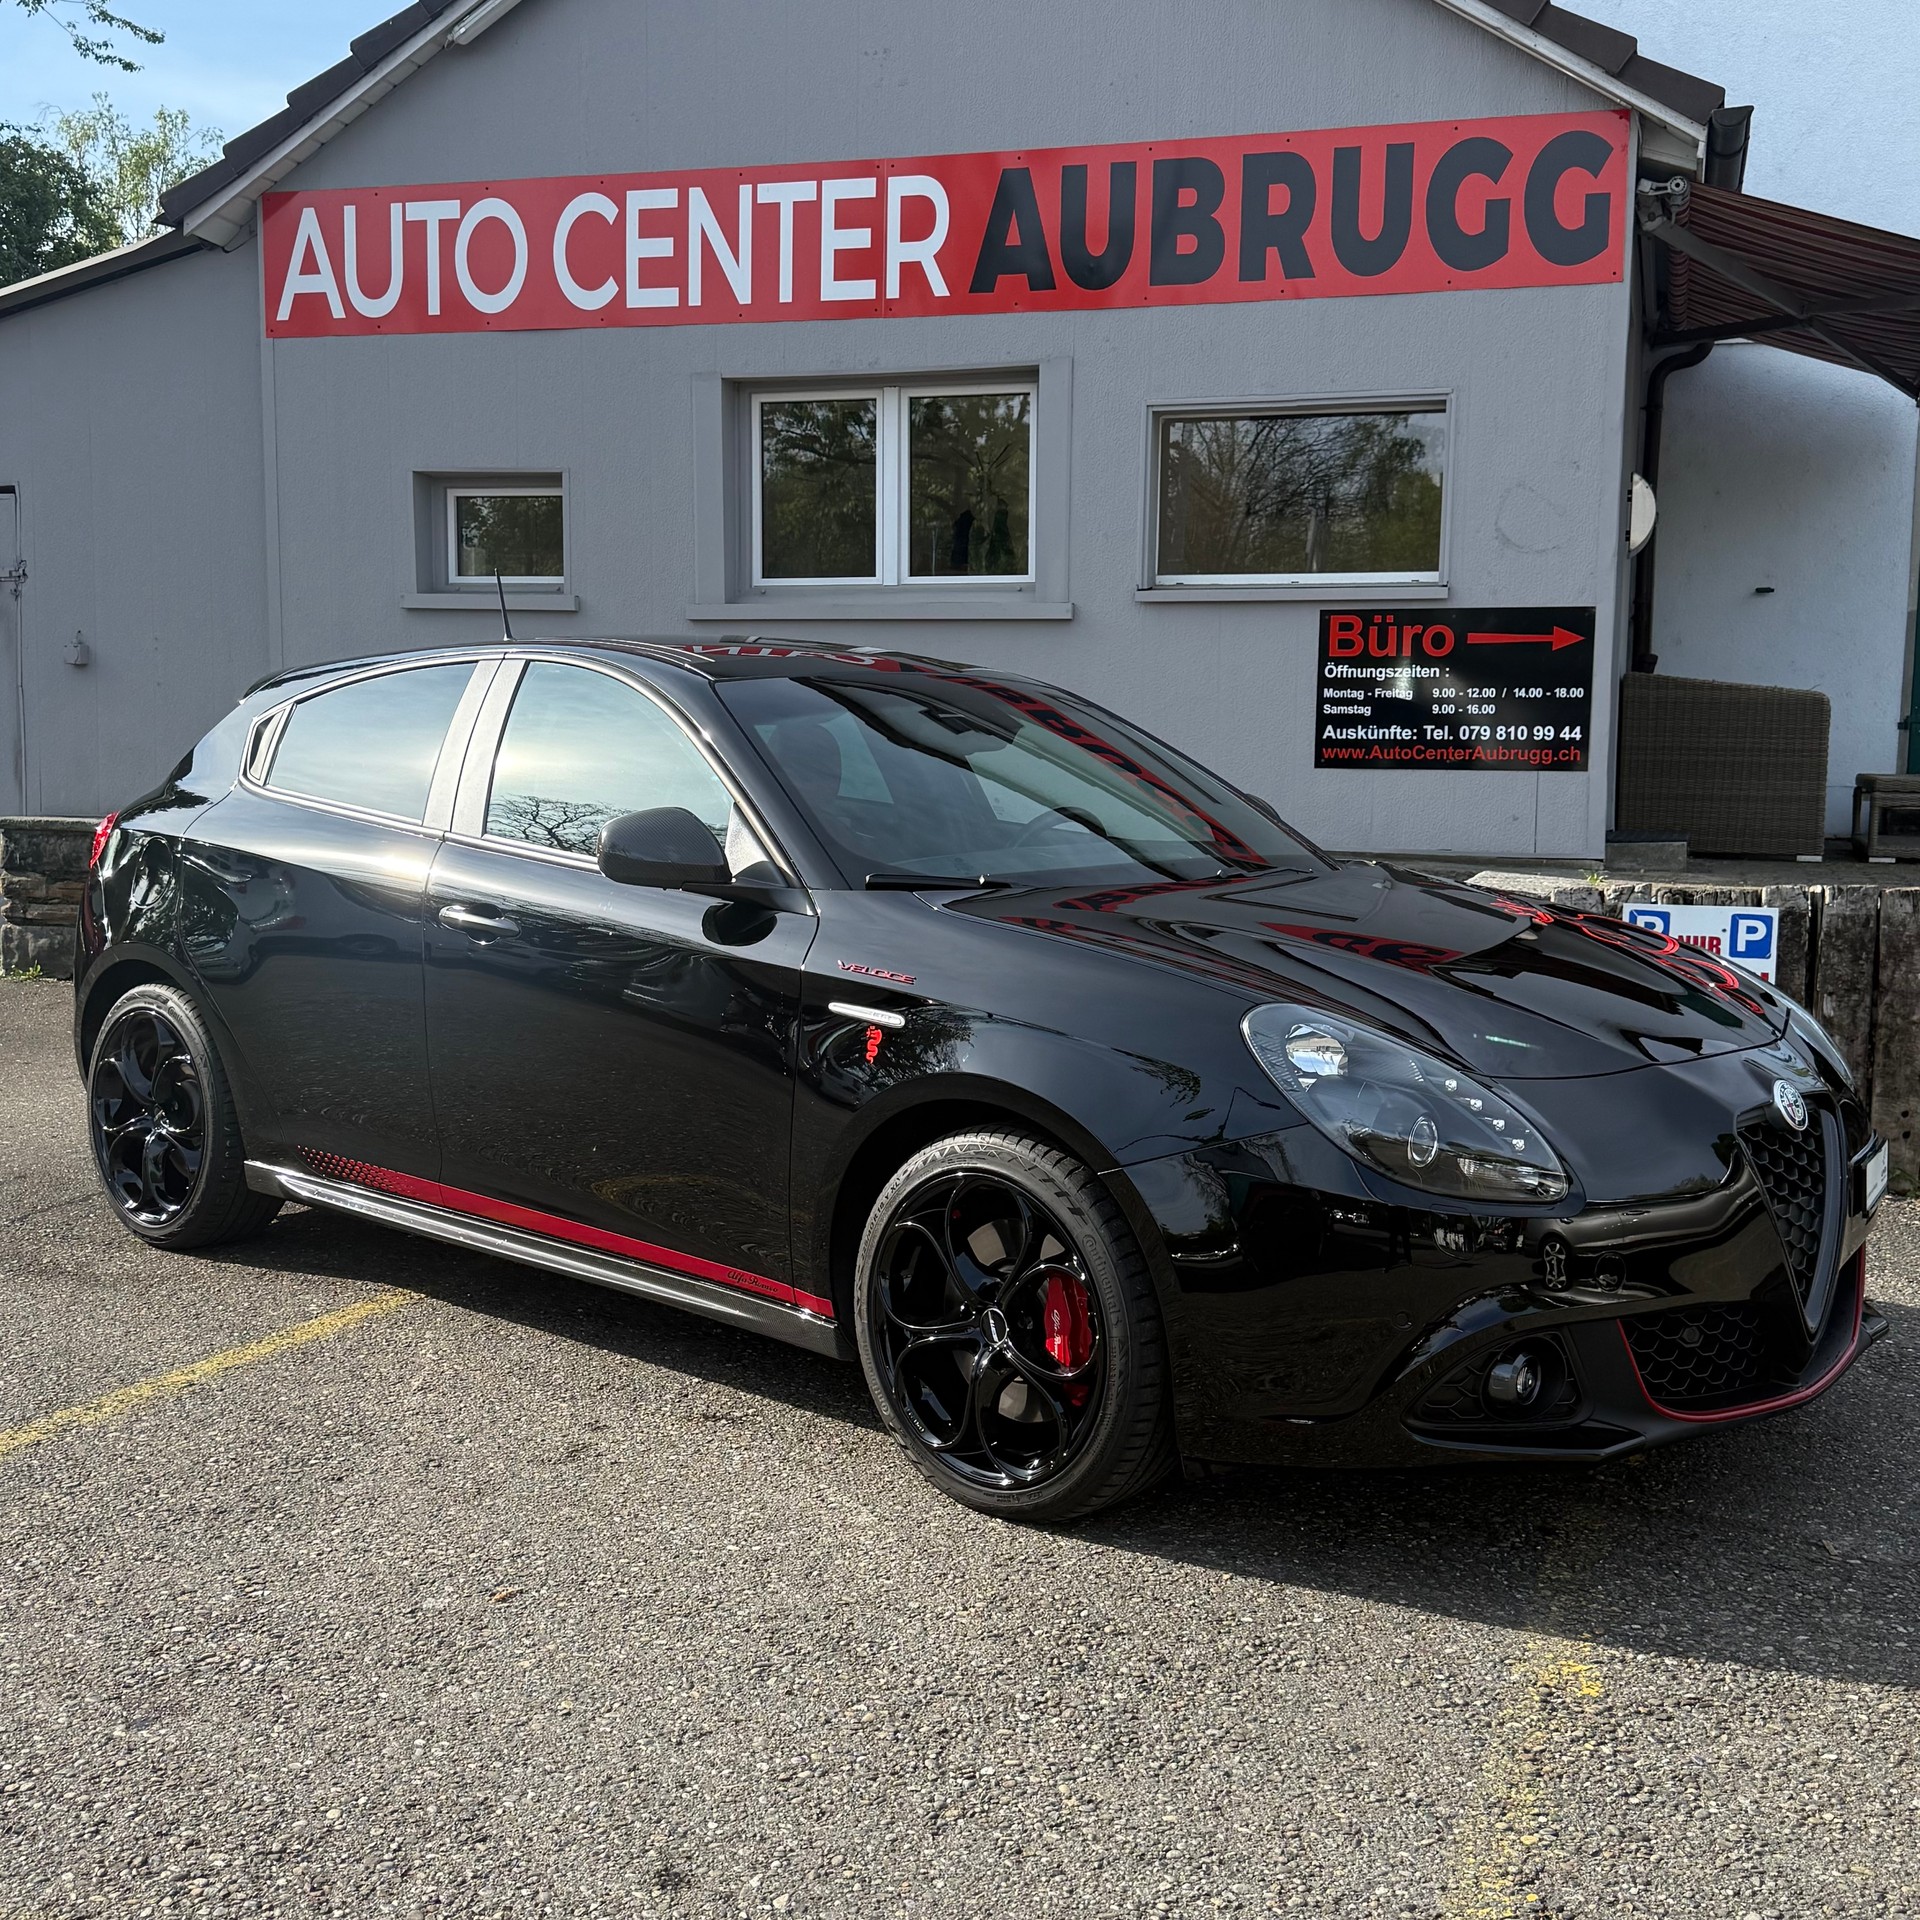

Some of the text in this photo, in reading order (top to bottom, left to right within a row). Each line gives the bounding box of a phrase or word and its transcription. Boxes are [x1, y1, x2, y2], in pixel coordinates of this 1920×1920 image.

[276, 130, 1615, 321] AUTO CENTER AUBRUGG
[1328, 614, 1455, 658] Büro
[1324, 662, 1440, 680] Öffnungszeiten
[1323, 688, 1365, 700] Montag
[1374, 688, 1413, 700] Freitag
[1432, 688, 1456, 698] 9.00
[1466, 688, 1496, 698] 12.00
[1513, 688, 1543, 698] 14.00
[1554, 688, 1584, 698] 18.00
[1323, 704, 1372, 716] Samstag
[1432, 704, 1455, 715] 9.00
[1466, 704, 1496, 715] 16.00
[1322, 725, 1583, 741] Auskünfte: Tel. 079 810 99 44
[1322, 745, 1581, 766] www.AutoCenterAubrugg.ch
[1737, 919, 1767, 952] P
[837, 960, 917, 985] VELOCE
